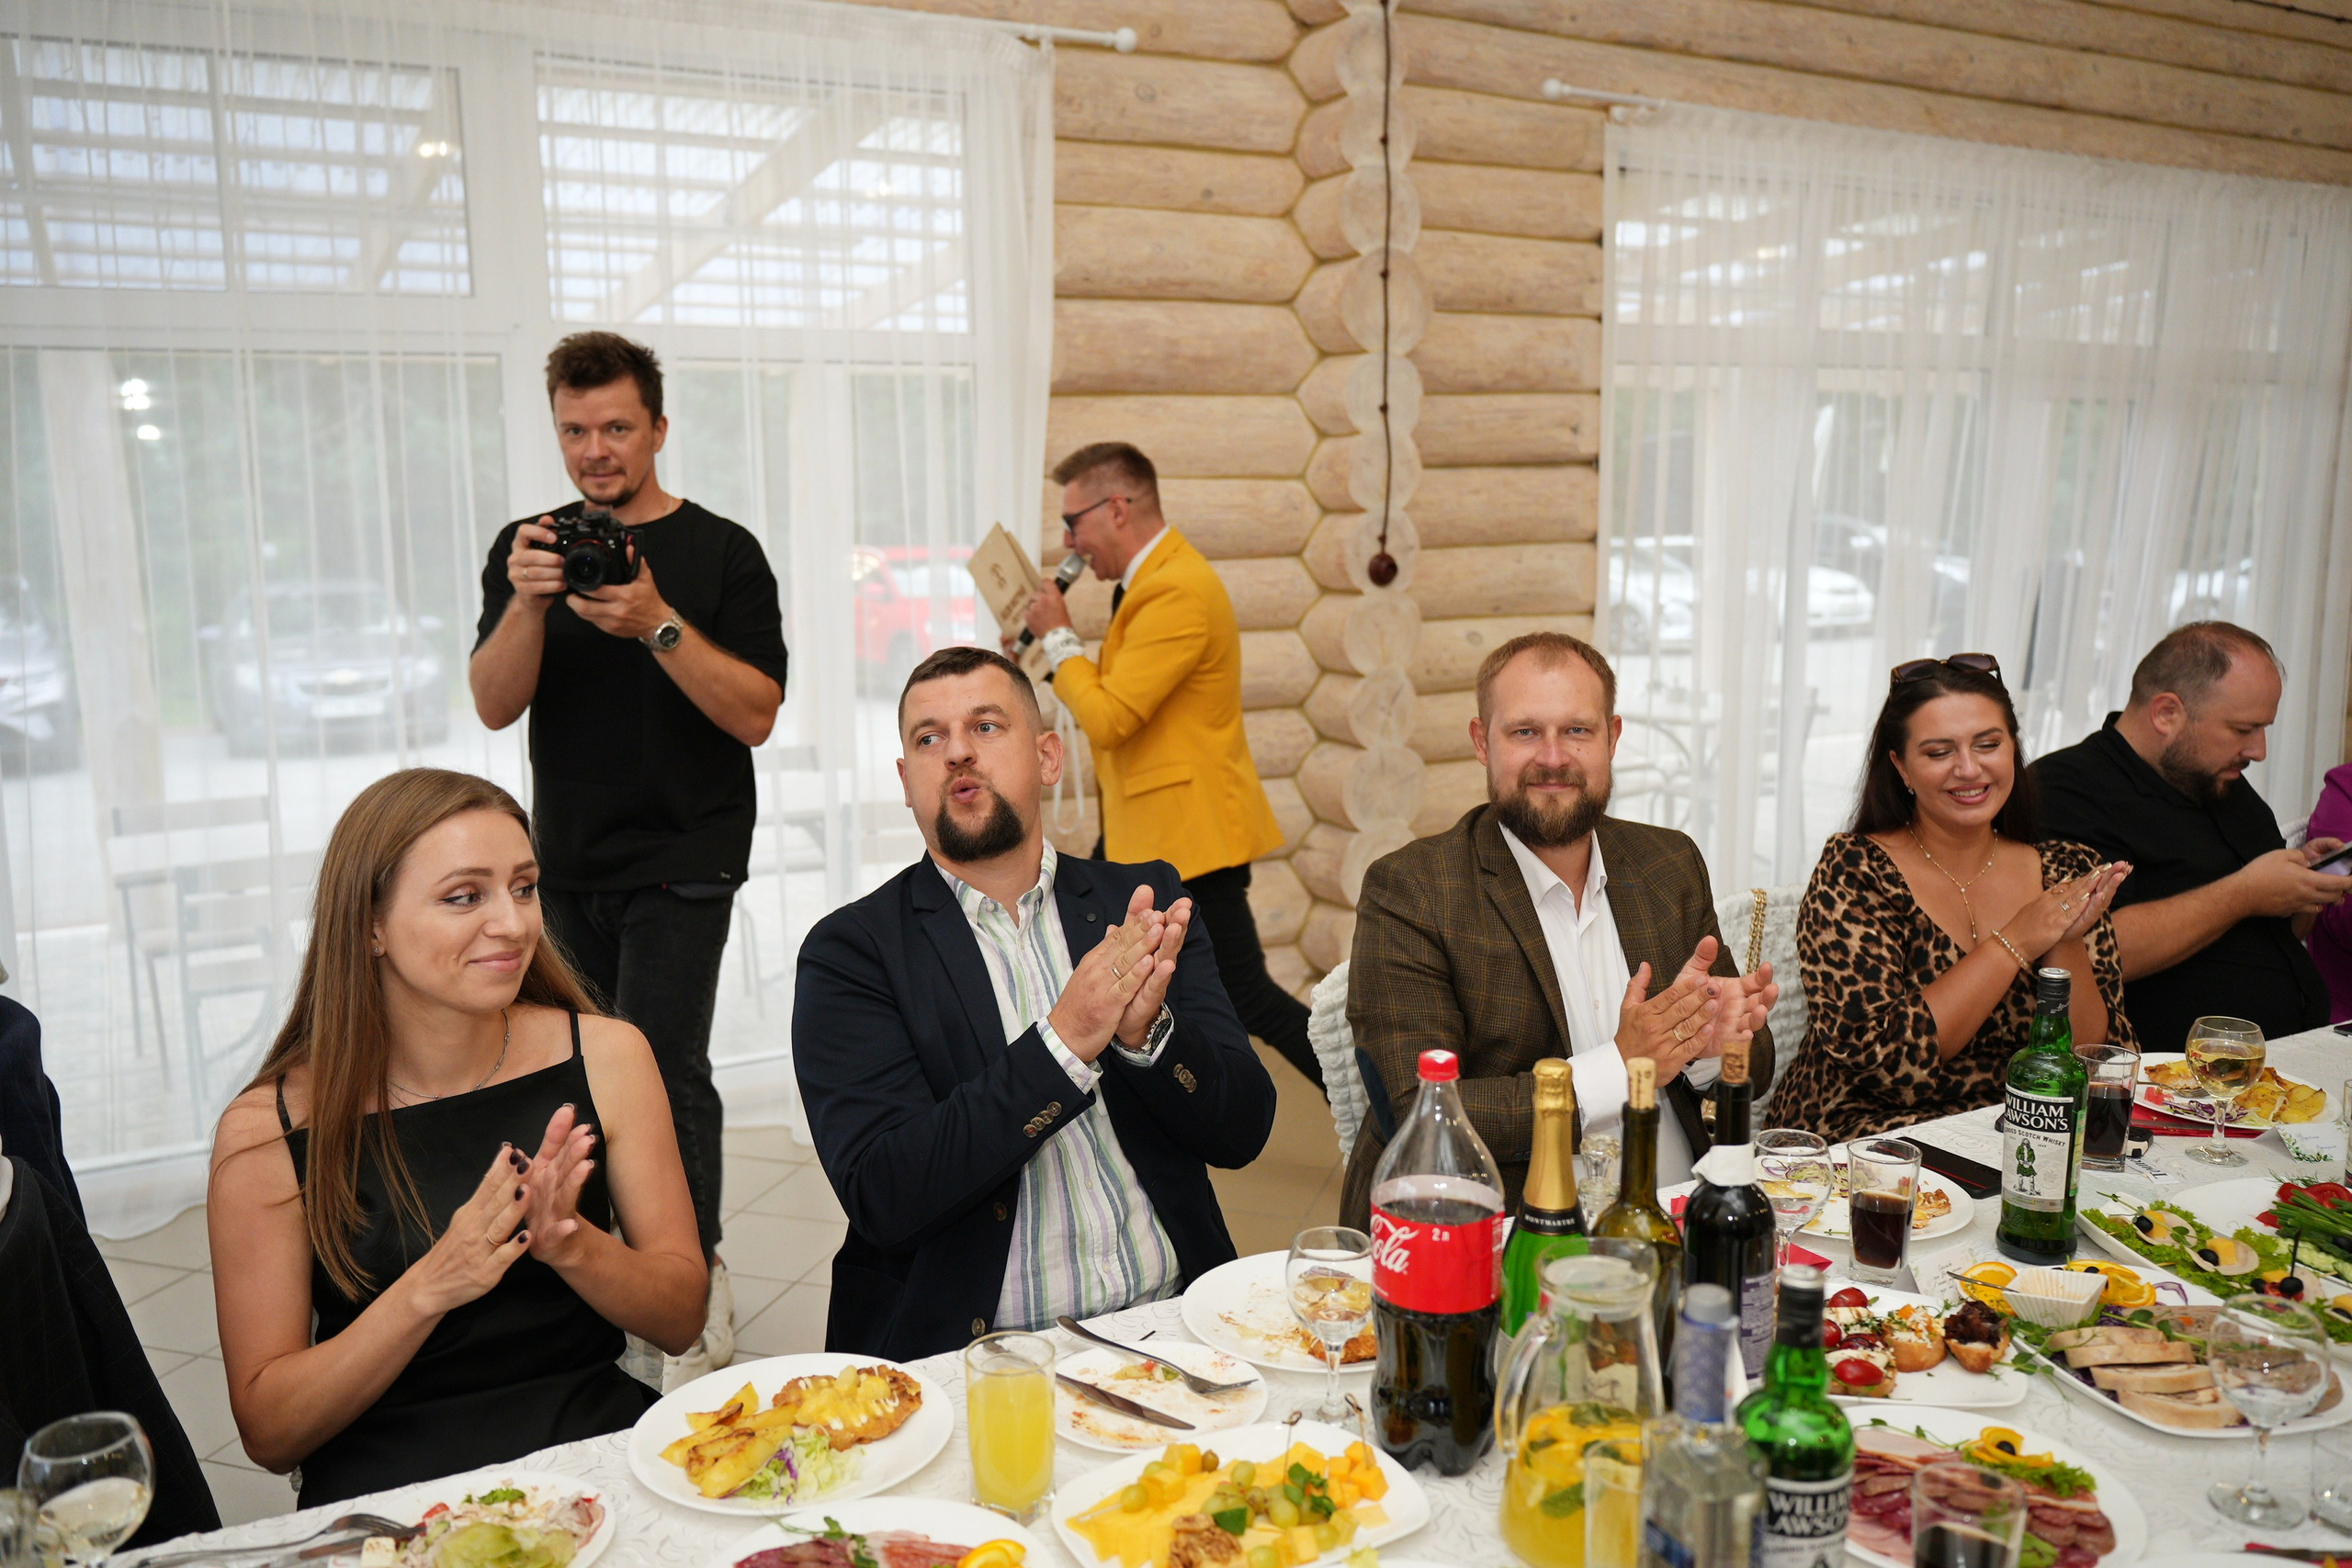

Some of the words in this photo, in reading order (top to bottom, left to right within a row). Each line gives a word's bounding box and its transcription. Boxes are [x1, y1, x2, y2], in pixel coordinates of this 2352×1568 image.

[2006, 1091, 2064, 1118] WILLIAM
[2018, 1129, 2041, 1141] SCOTCH
[2042, 1135, 2066, 1147] WHISKY
